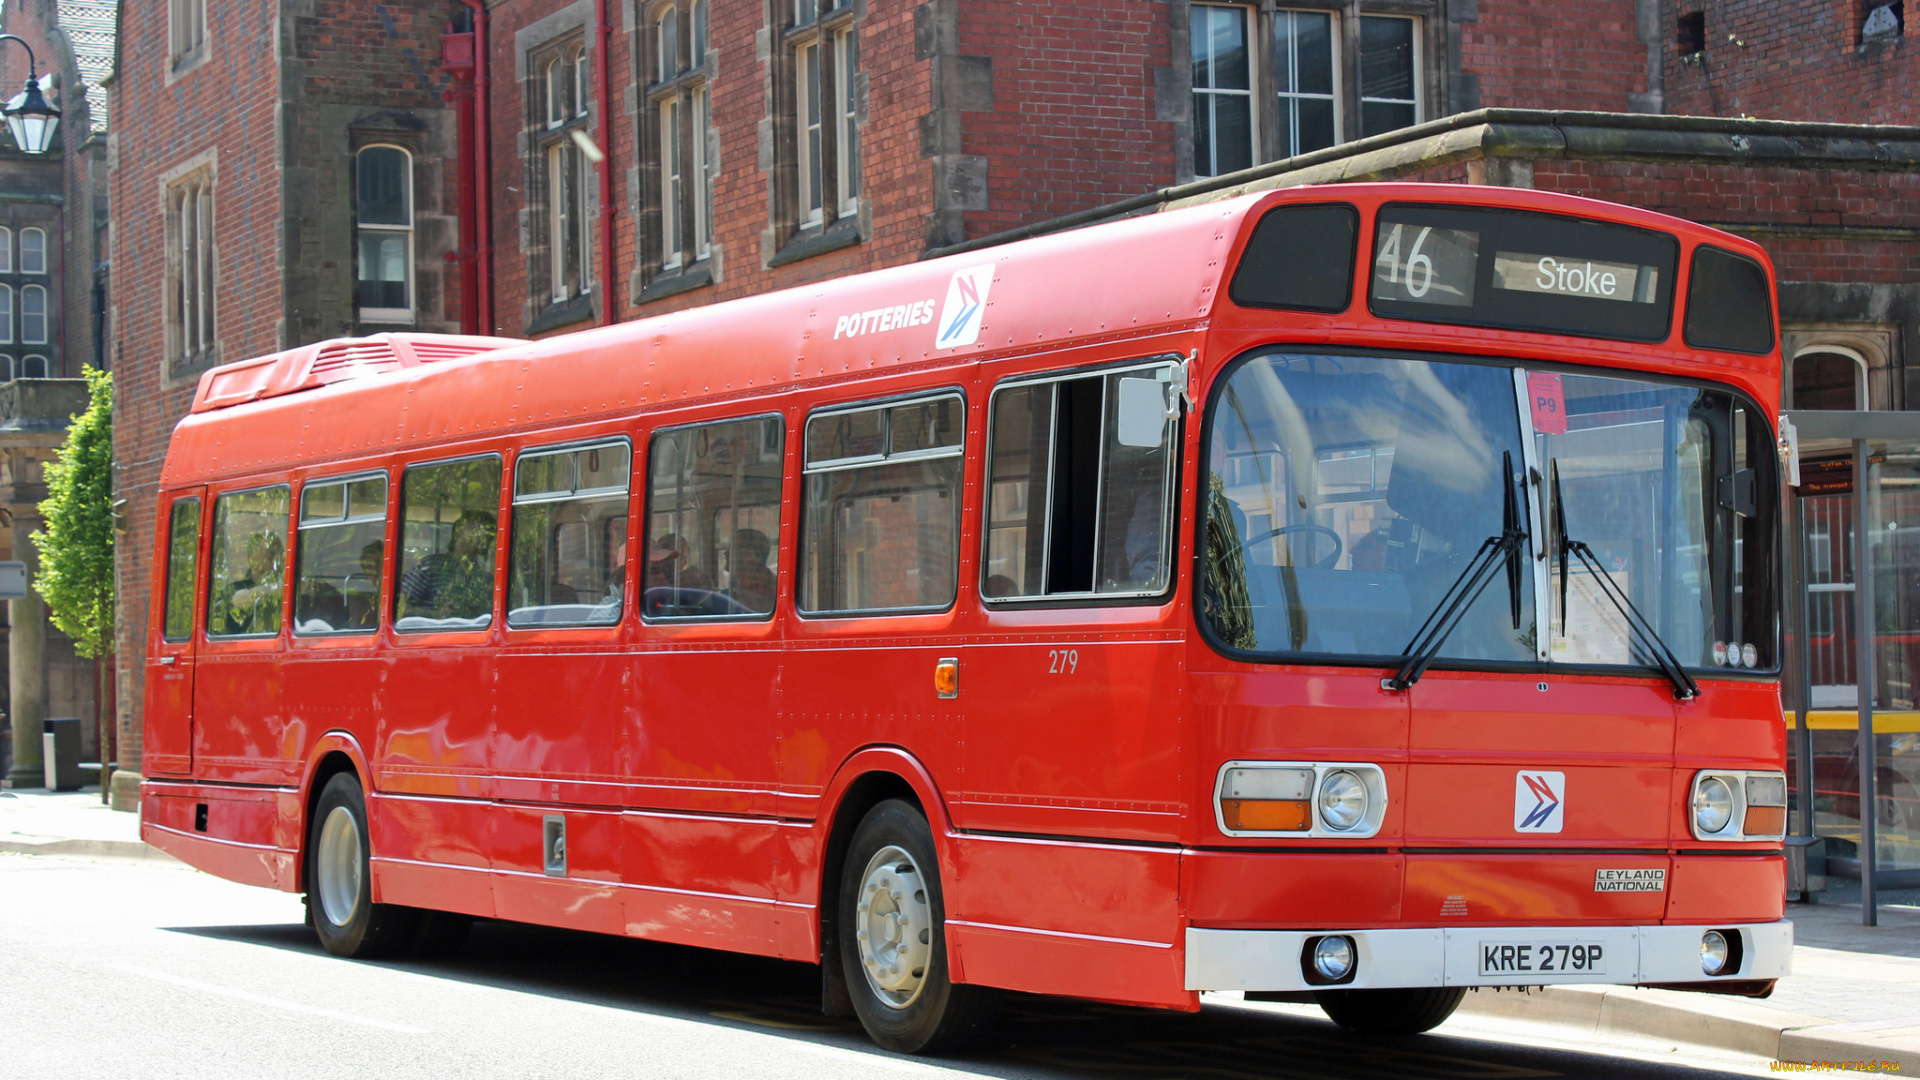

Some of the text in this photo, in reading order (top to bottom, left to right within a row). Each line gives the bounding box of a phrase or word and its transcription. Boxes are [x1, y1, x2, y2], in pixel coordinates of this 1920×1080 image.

[1376, 223, 1432, 298] 46
[1536, 256, 1616, 296] Stoke
[833, 298, 935, 340] POTTERIES
[1537, 396, 1557, 413] P9
[1049, 649, 1078, 674] 279
[1596, 881, 1662, 891] NATIONAL
[1597, 870, 1664, 880] LEYLAND
[1484, 945, 1603, 971] KRE 279P
